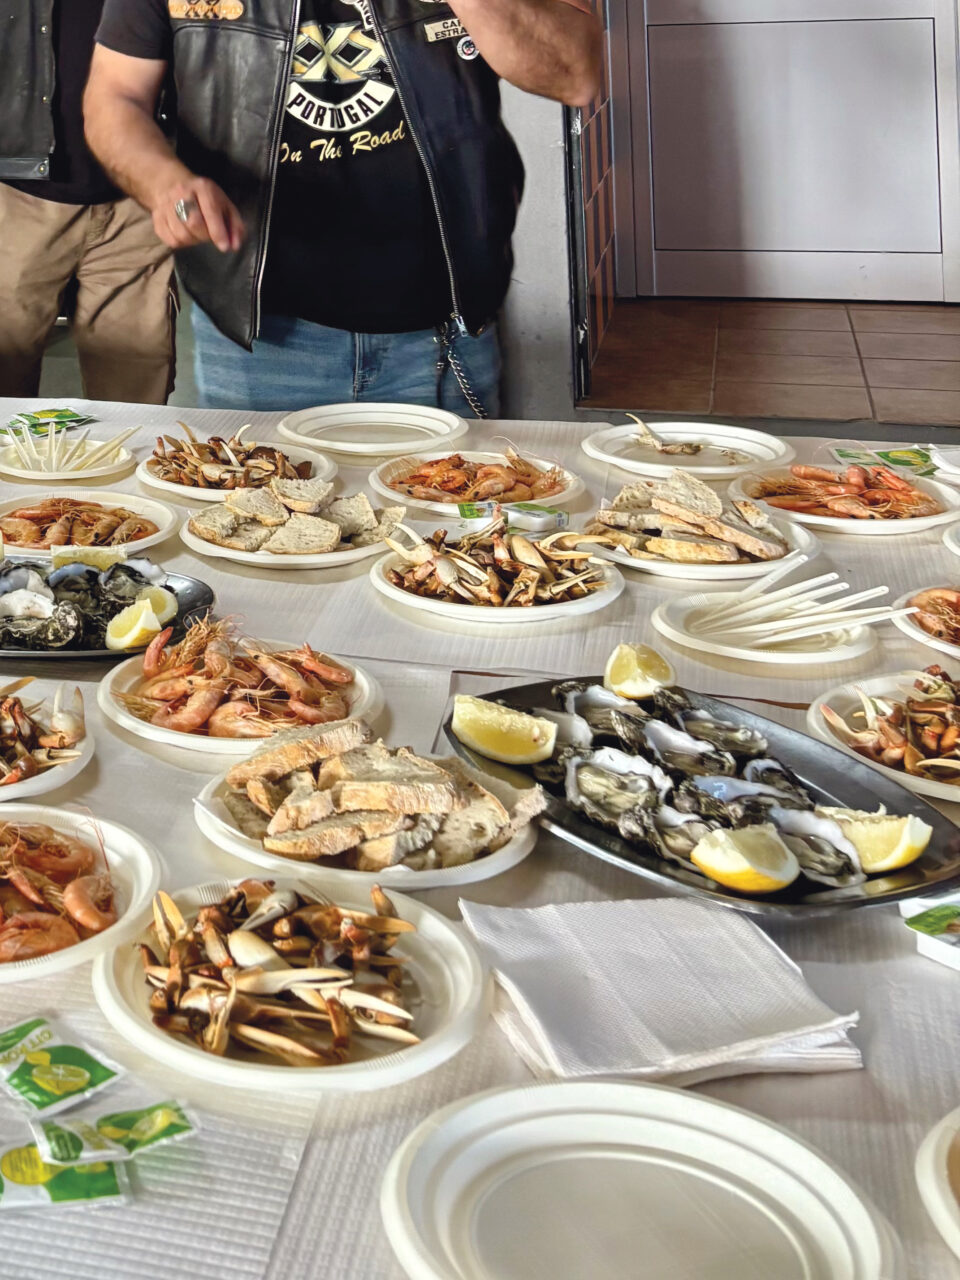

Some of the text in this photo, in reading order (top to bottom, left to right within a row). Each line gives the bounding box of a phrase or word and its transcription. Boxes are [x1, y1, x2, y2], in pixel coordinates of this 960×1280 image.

[434, 27, 467, 39] ESTRA
[289, 91, 384, 129] PORTUGAL
[310, 137, 342, 161] The
[349, 120, 405, 155] Road
